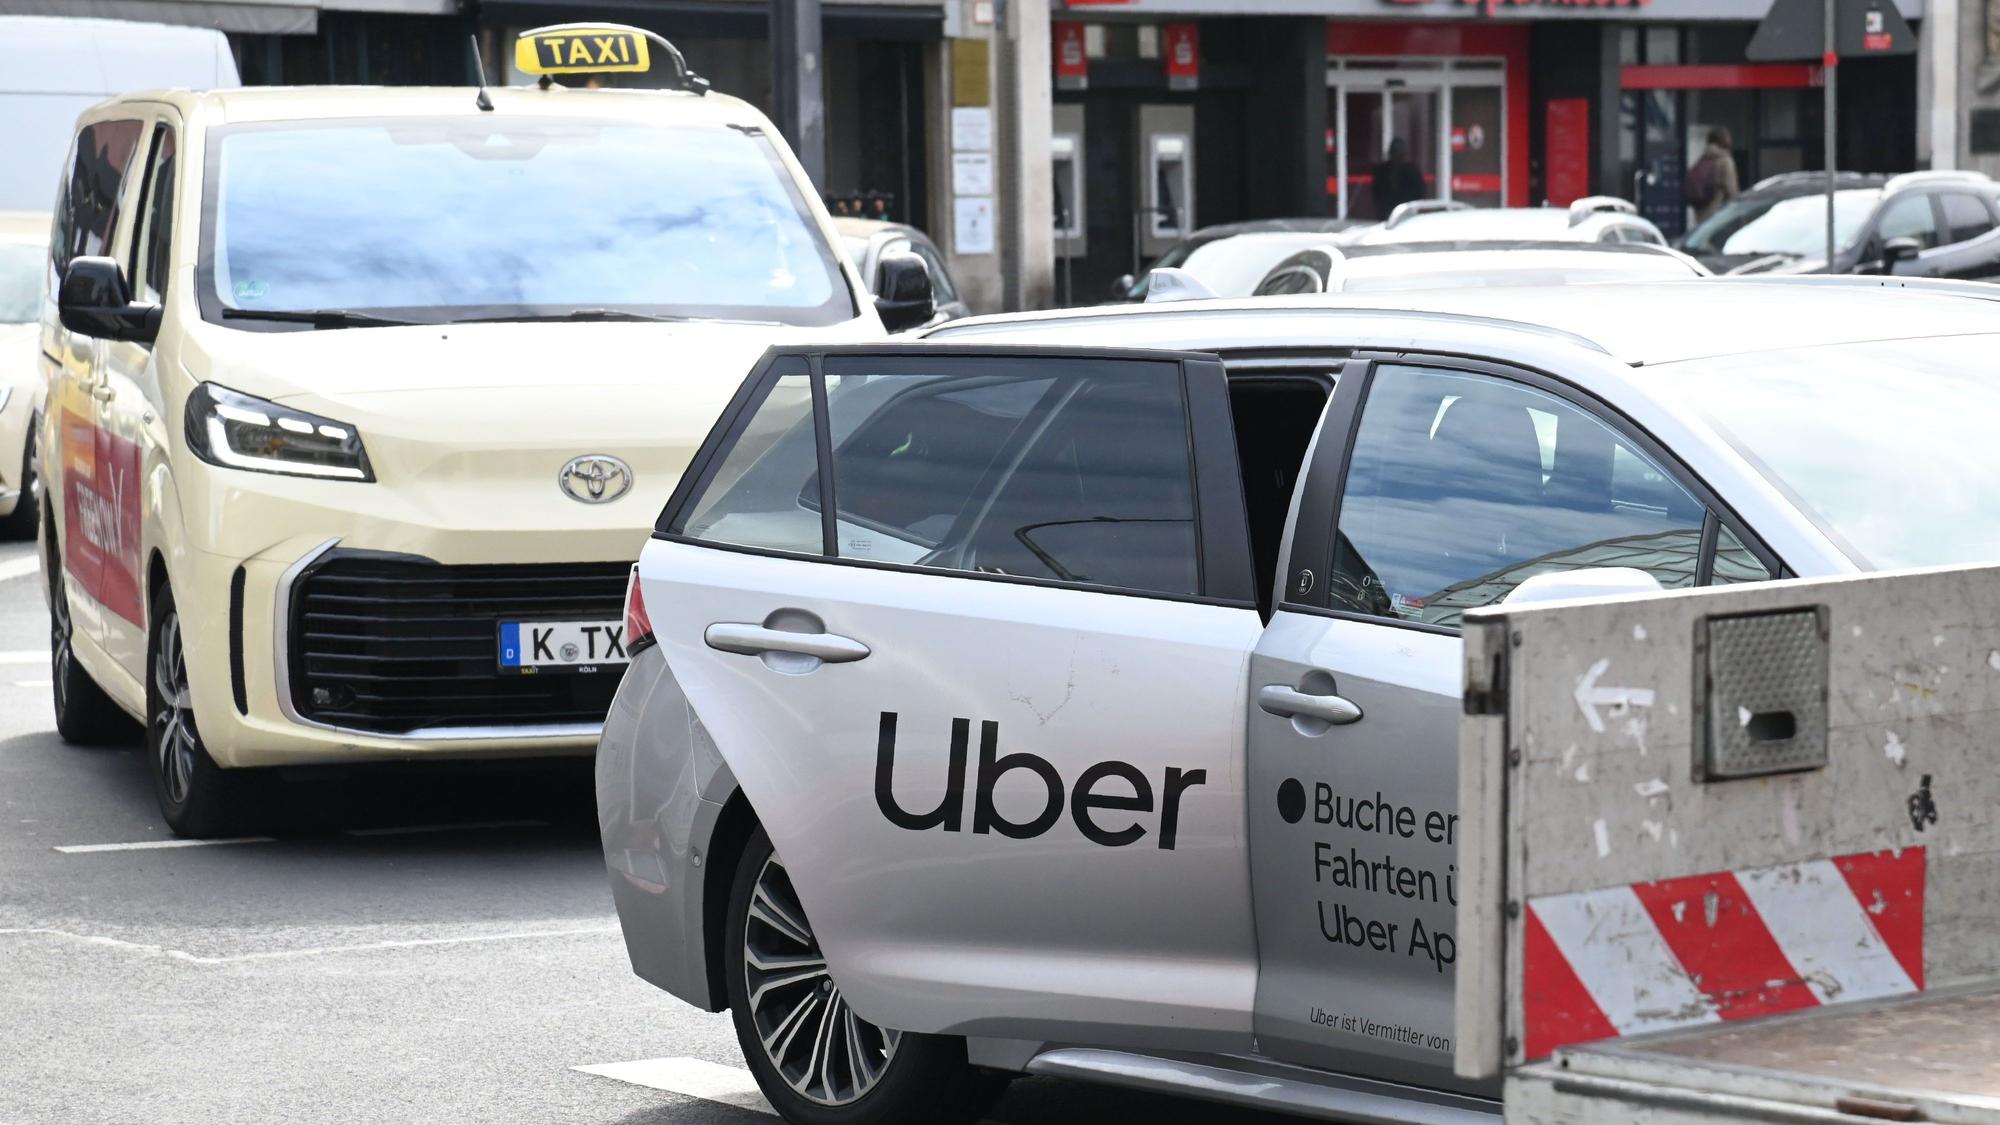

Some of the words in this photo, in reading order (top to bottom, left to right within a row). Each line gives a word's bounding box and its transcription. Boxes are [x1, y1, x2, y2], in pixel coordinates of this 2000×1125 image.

[543, 37, 630, 64] TAXI
[506, 648, 514, 659] D
[533, 627, 555, 661] K
[580, 625, 625, 660] TX
[874, 710, 1208, 852] Uber
[1314, 781, 1417, 839] Buche
[1314, 841, 1438, 903] Fahrten
[1317, 900, 1398, 953] Uber
[1408, 917, 1457, 973] Ap
[1310, 1007, 1339, 1028] Uber
[1341, 1013, 1356, 1032] ist
[1359, 1017, 1424, 1046] Vermittler
[1426, 1034, 1450, 1051] von
